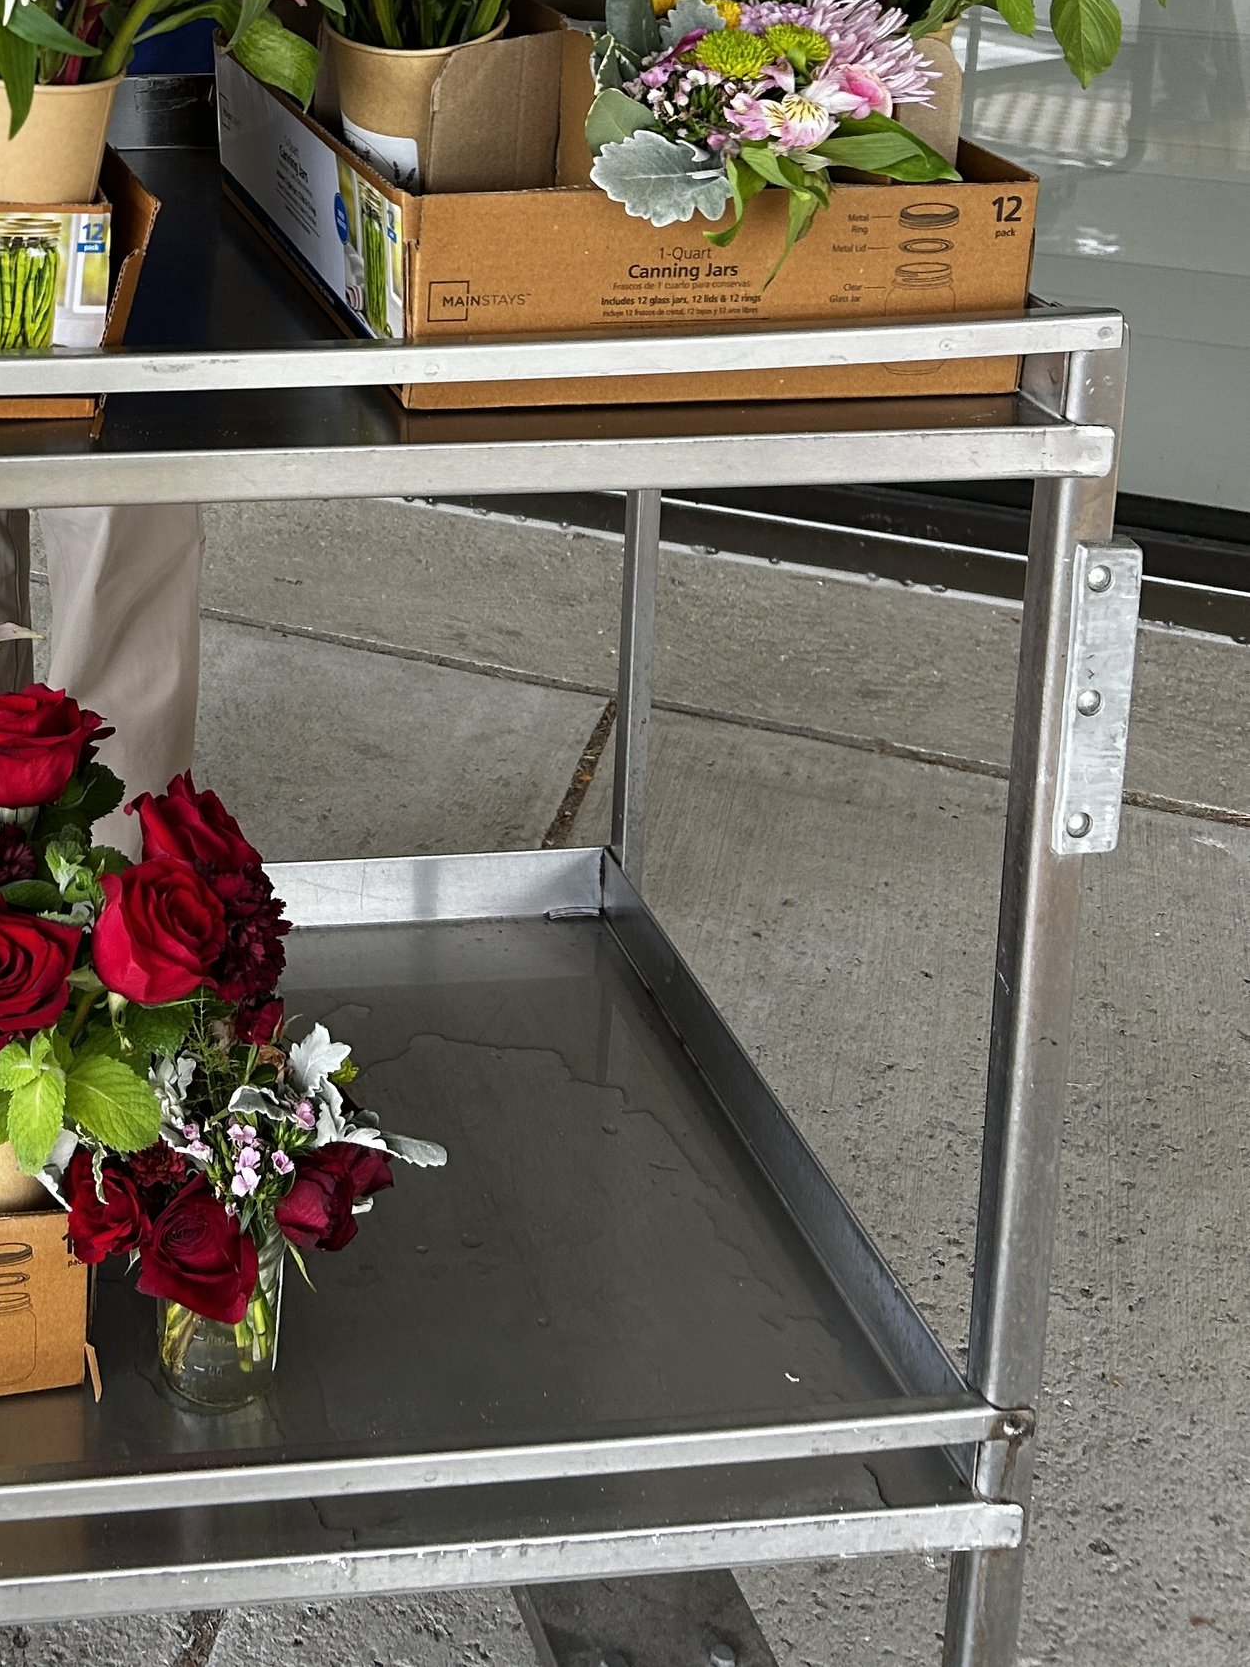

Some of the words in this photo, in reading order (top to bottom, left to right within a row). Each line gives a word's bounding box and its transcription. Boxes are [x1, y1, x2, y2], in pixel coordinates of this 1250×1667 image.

[991, 195, 1023, 223] 12
[82, 223, 104, 241] 12
[851, 224, 869, 235] Ring
[994, 227, 1016, 239] pack
[659, 246, 712, 262] 1-Quart
[628, 262, 700, 281] Canning
[705, 262, 739, 277] Jars
[643, 281, 655, 290] de
[601, 296, 636, 306] Includes
[637, 296, 648, 305] 12
[649, 295, 670, 307] glass
[692, 294, 703, 304] 12
[703, 294, 718, 303] lids
[730, 293, 740, 303] 12
[741, 291, 762, 304] rings
